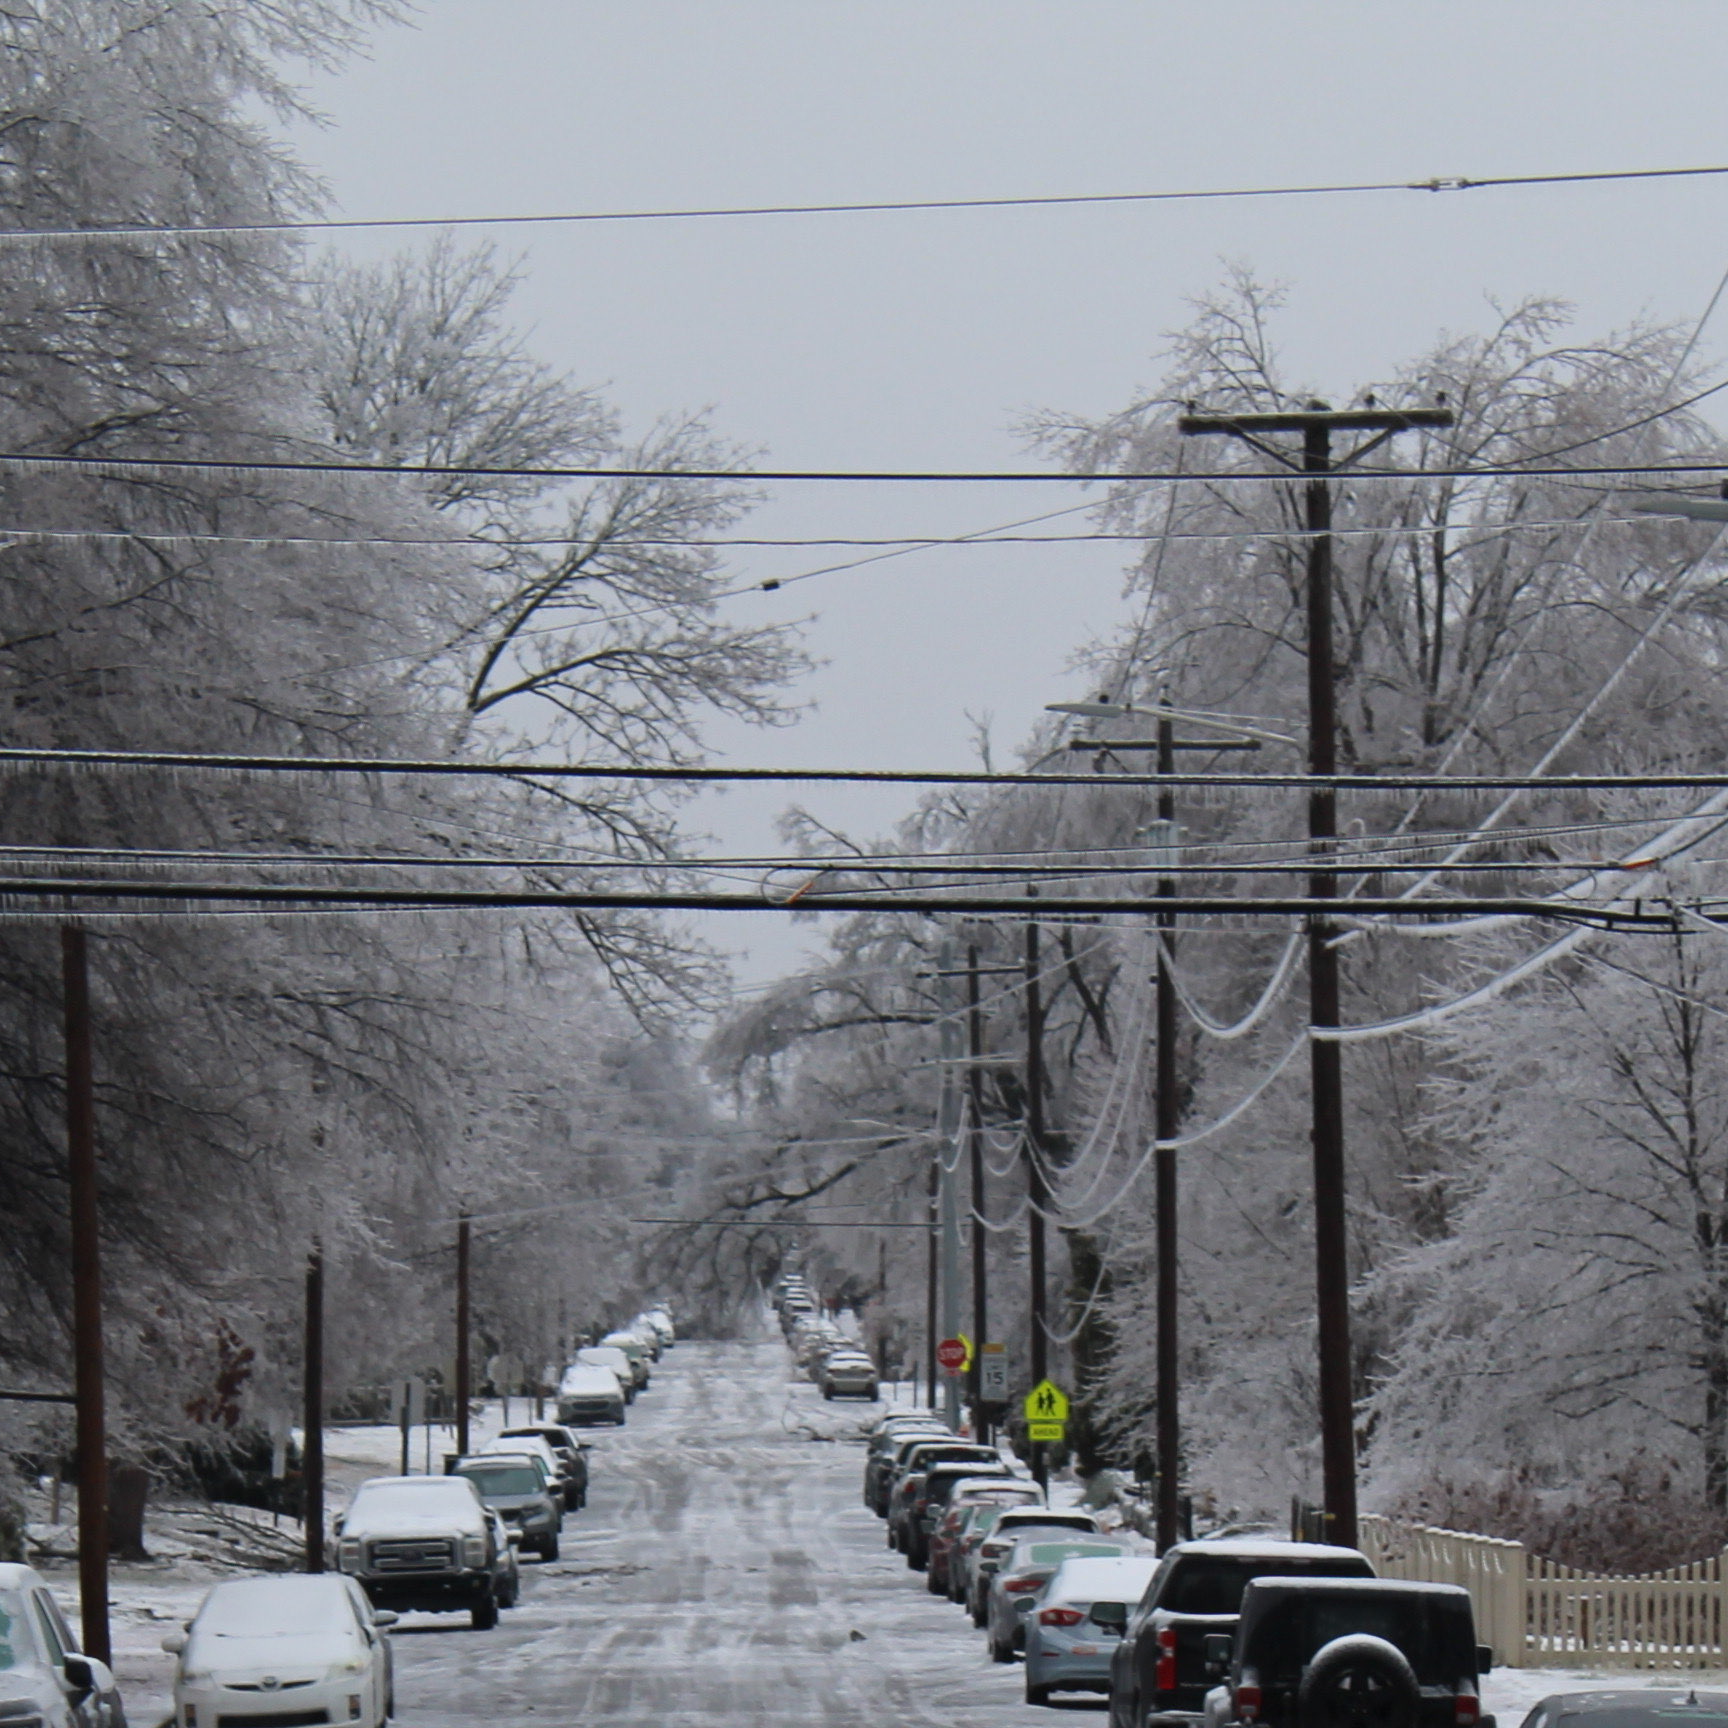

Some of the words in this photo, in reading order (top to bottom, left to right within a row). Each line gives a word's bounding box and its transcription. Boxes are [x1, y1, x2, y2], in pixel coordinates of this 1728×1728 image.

[937, 1347, 965, 1359] STOP
[986, 1371, 1004, 1386] 15
[1032, 1427, 1059, 1438] AHEAD
